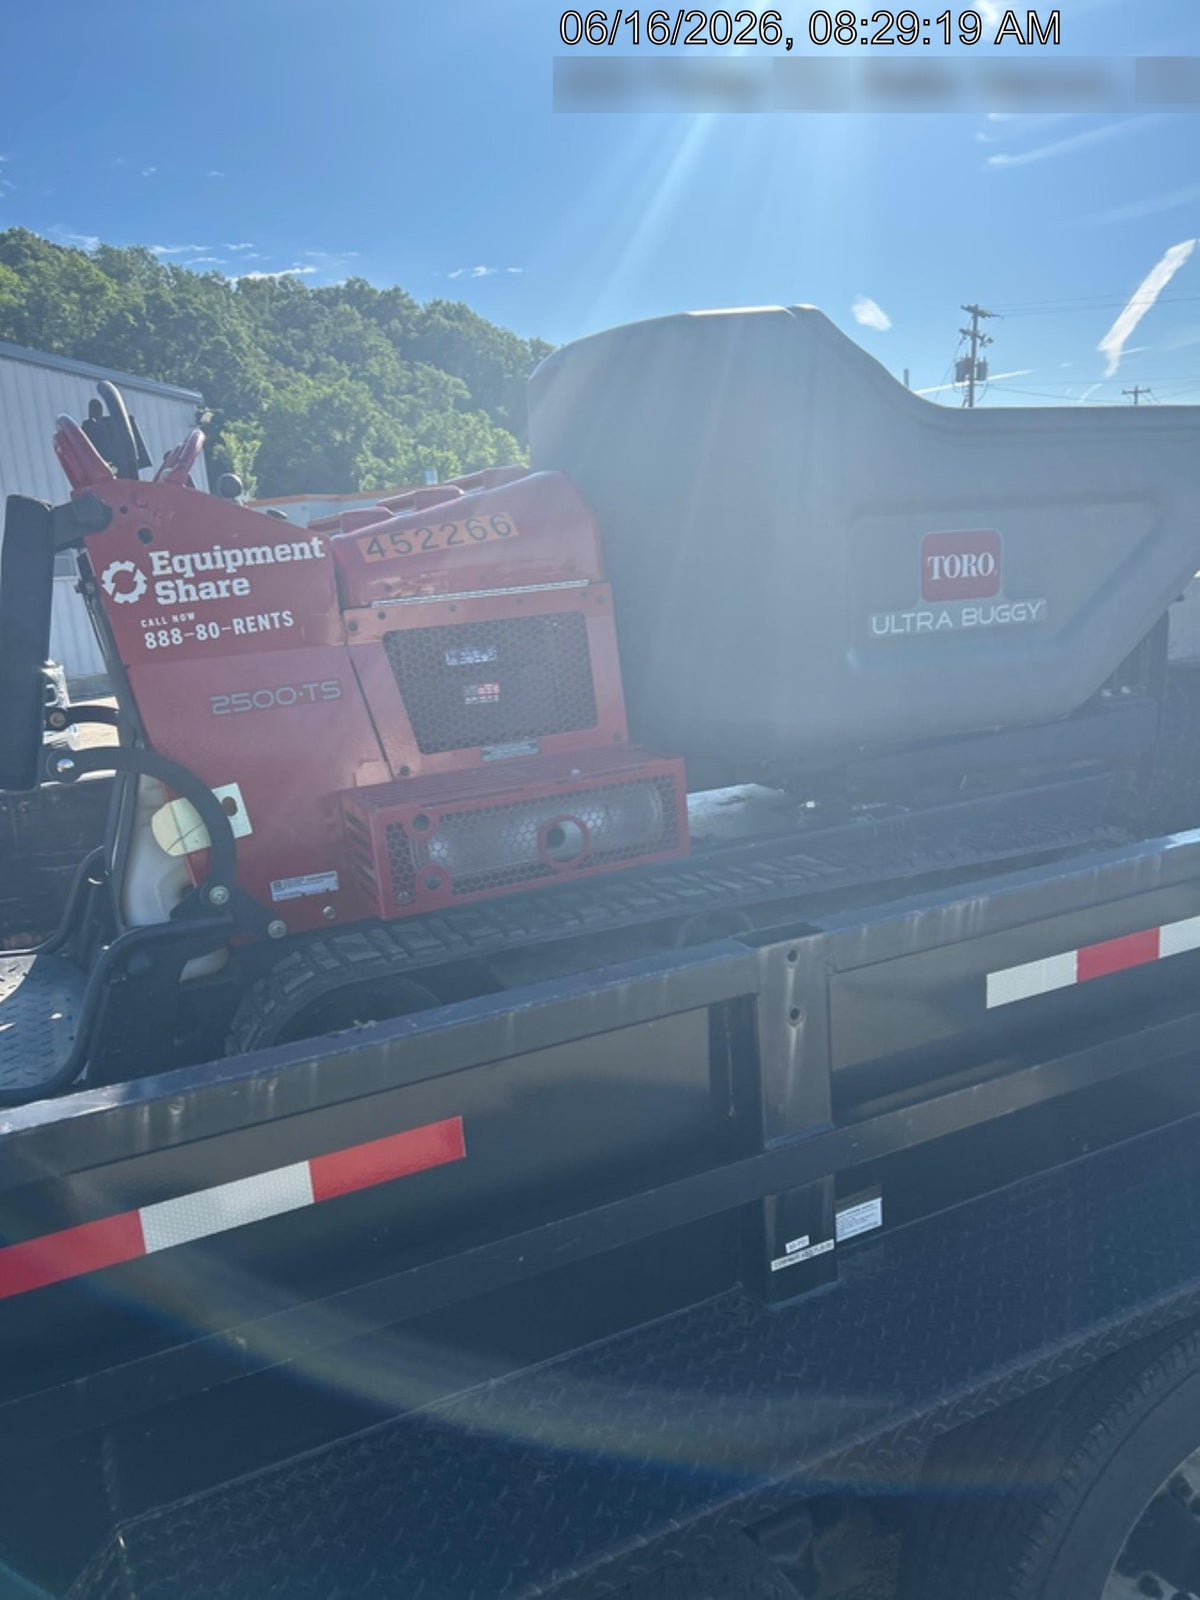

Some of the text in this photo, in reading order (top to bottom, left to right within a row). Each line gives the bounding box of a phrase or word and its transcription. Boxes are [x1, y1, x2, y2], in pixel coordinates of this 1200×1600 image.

[366, 513, 512, 558] 452266
[149, 536, 326, 579] Equipment
[927, 552, 996, 580] TORO
[155, 576, 251, 605] Share
[140, 612, 196, 629] CALL NOW
[144, 610, 294, 650] 888-80-RENTS
[872, 602, 1042, 634] ULTRA BUGGY
